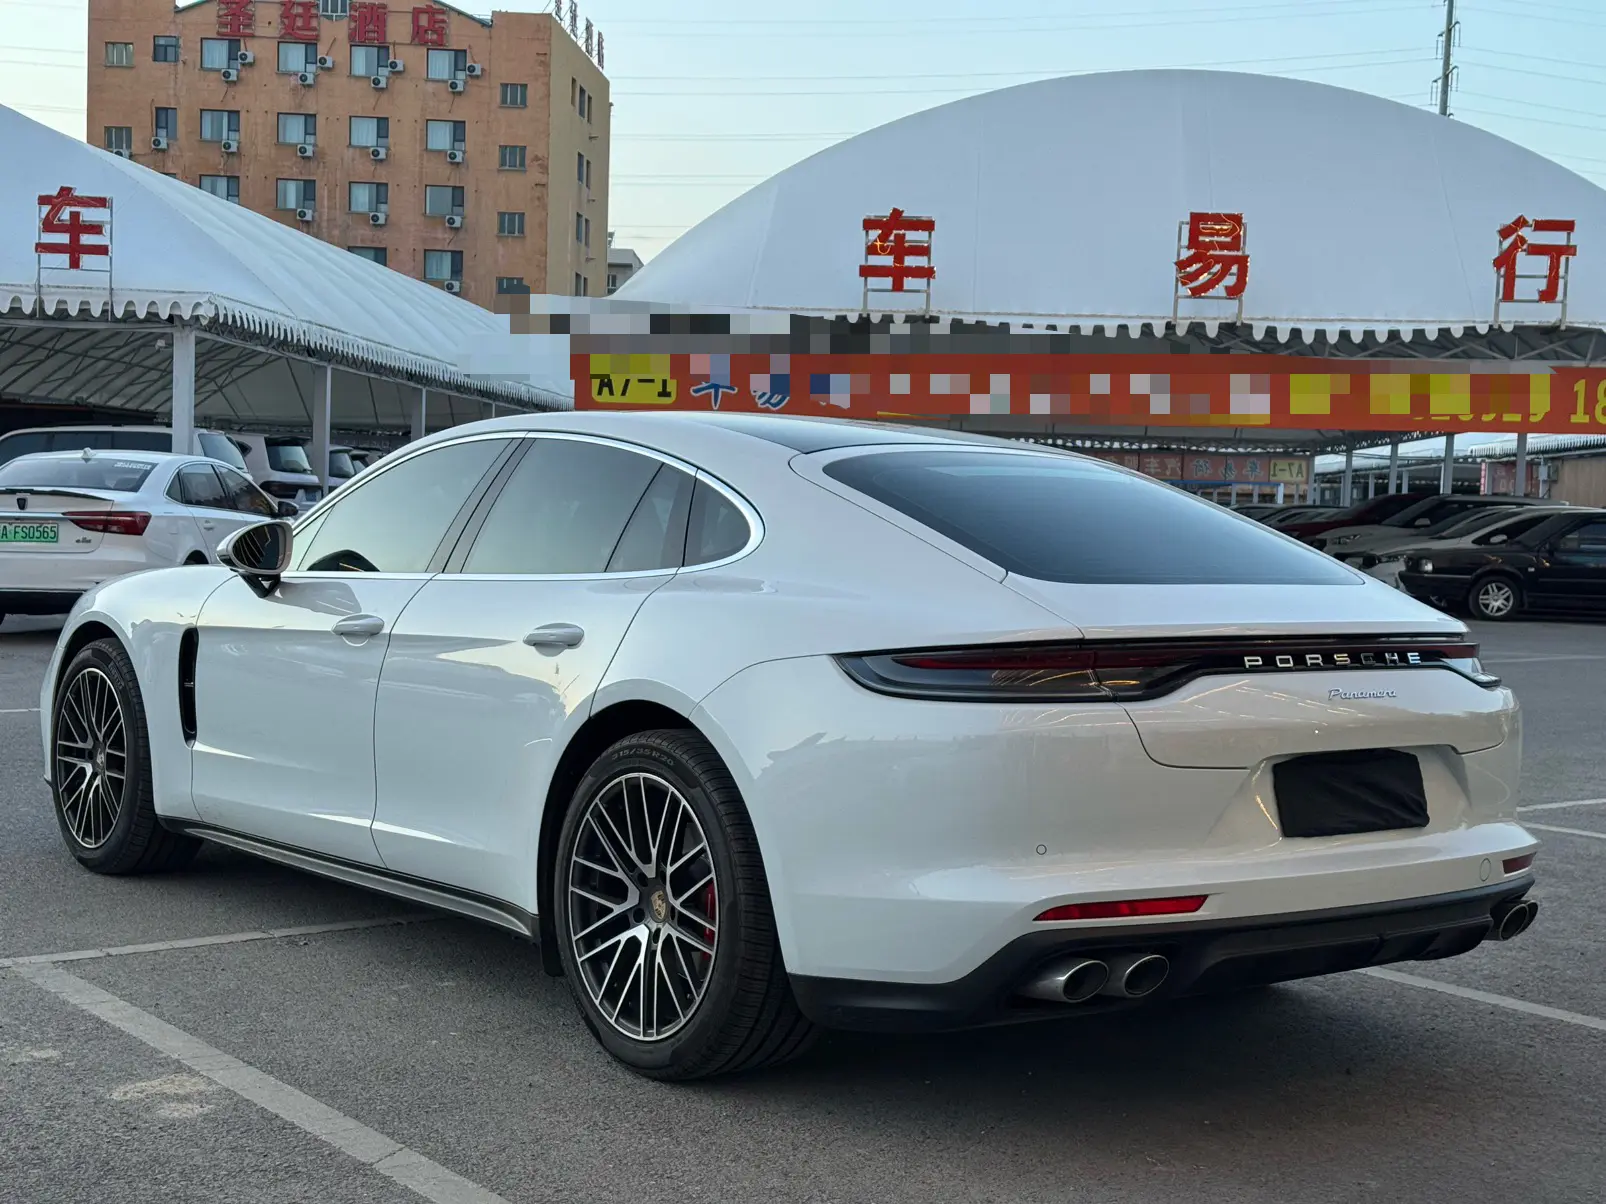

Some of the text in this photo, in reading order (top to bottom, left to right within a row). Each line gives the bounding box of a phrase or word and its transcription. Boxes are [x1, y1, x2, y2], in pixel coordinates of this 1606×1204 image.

[35, 186, 110, 270] 车
[1244, 652, 1422, 668] PORSCHE
[1328, 688, 1397, 701] Panamera
